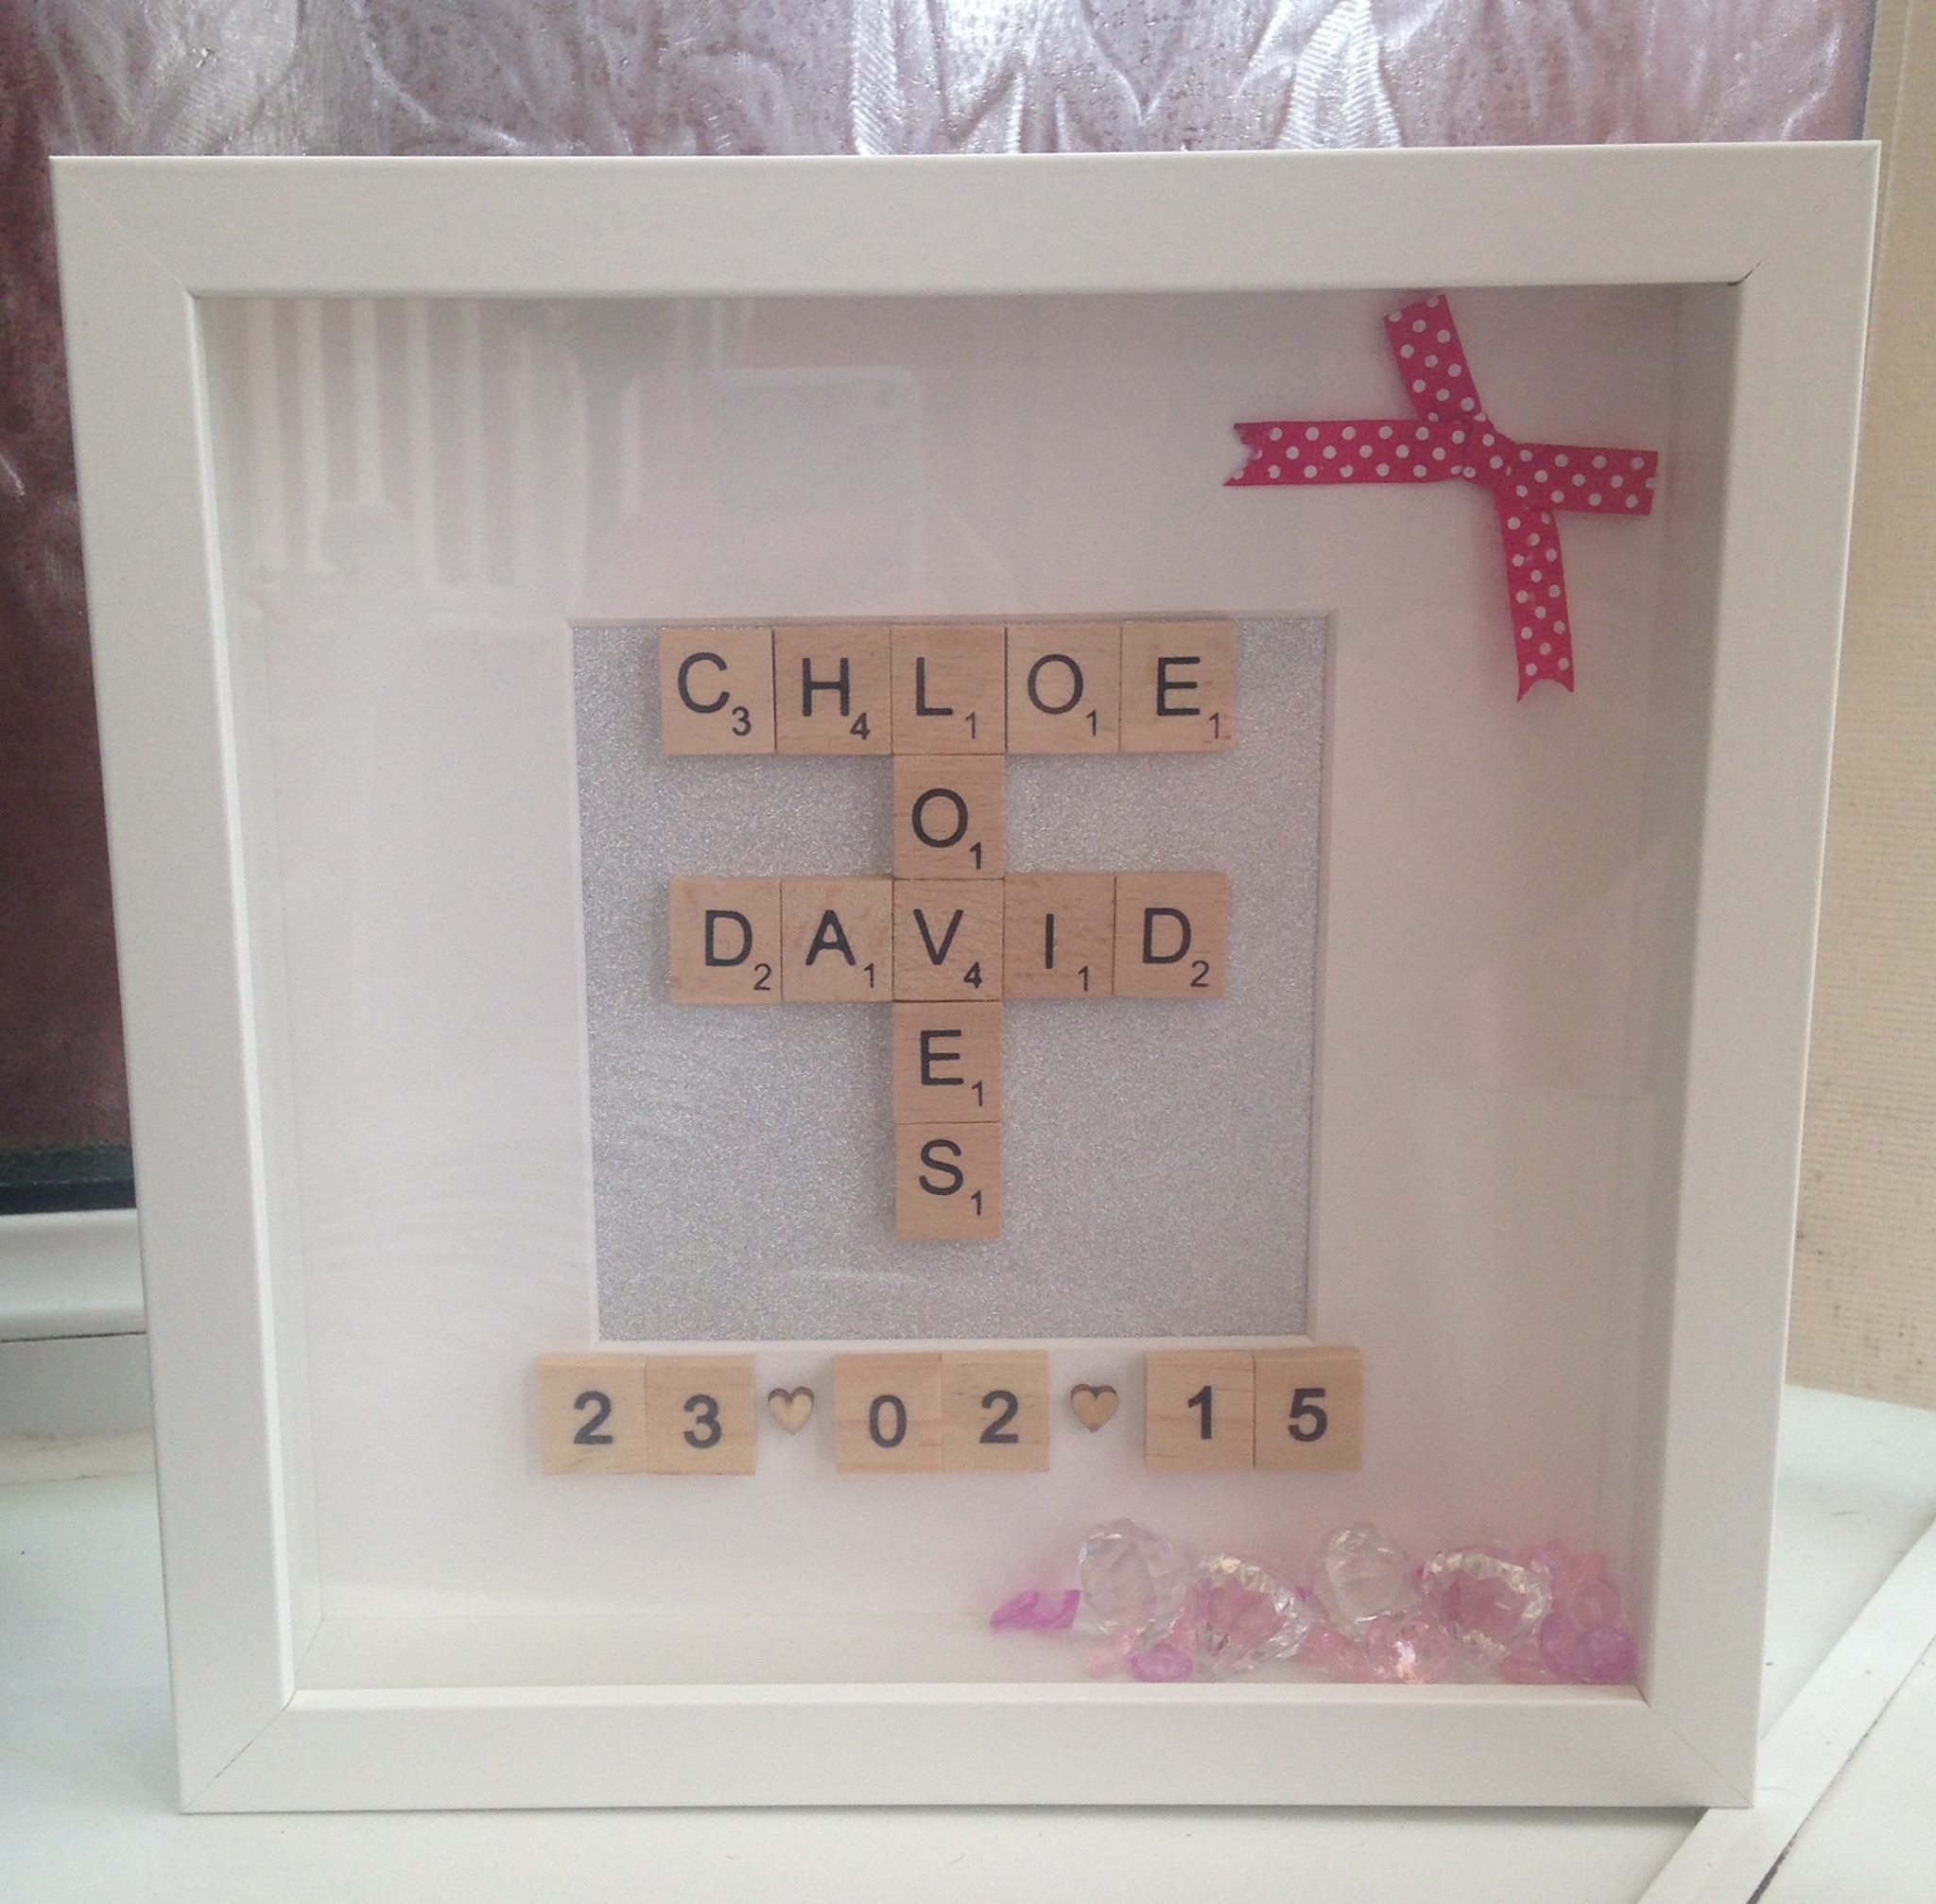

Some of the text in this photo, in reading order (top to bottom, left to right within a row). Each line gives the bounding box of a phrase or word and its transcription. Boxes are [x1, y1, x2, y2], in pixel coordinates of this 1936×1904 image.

[677, 651, 1201, 718] CHLOE
[732, 705, 1219, 741] 3 4 1 1 1
[969, 841, 982, 871] 1
[704, 907, 1192, 970] DAVID
[911, 656, 969, 1196] LOVES
[753, 960, 1210, 992] 2 1 4 1 2
[971, 1081, 983, 1107] 1
[970, 1189, 982, 1217] 1
[573, 1385, 1328, 1449] 23 02 15
